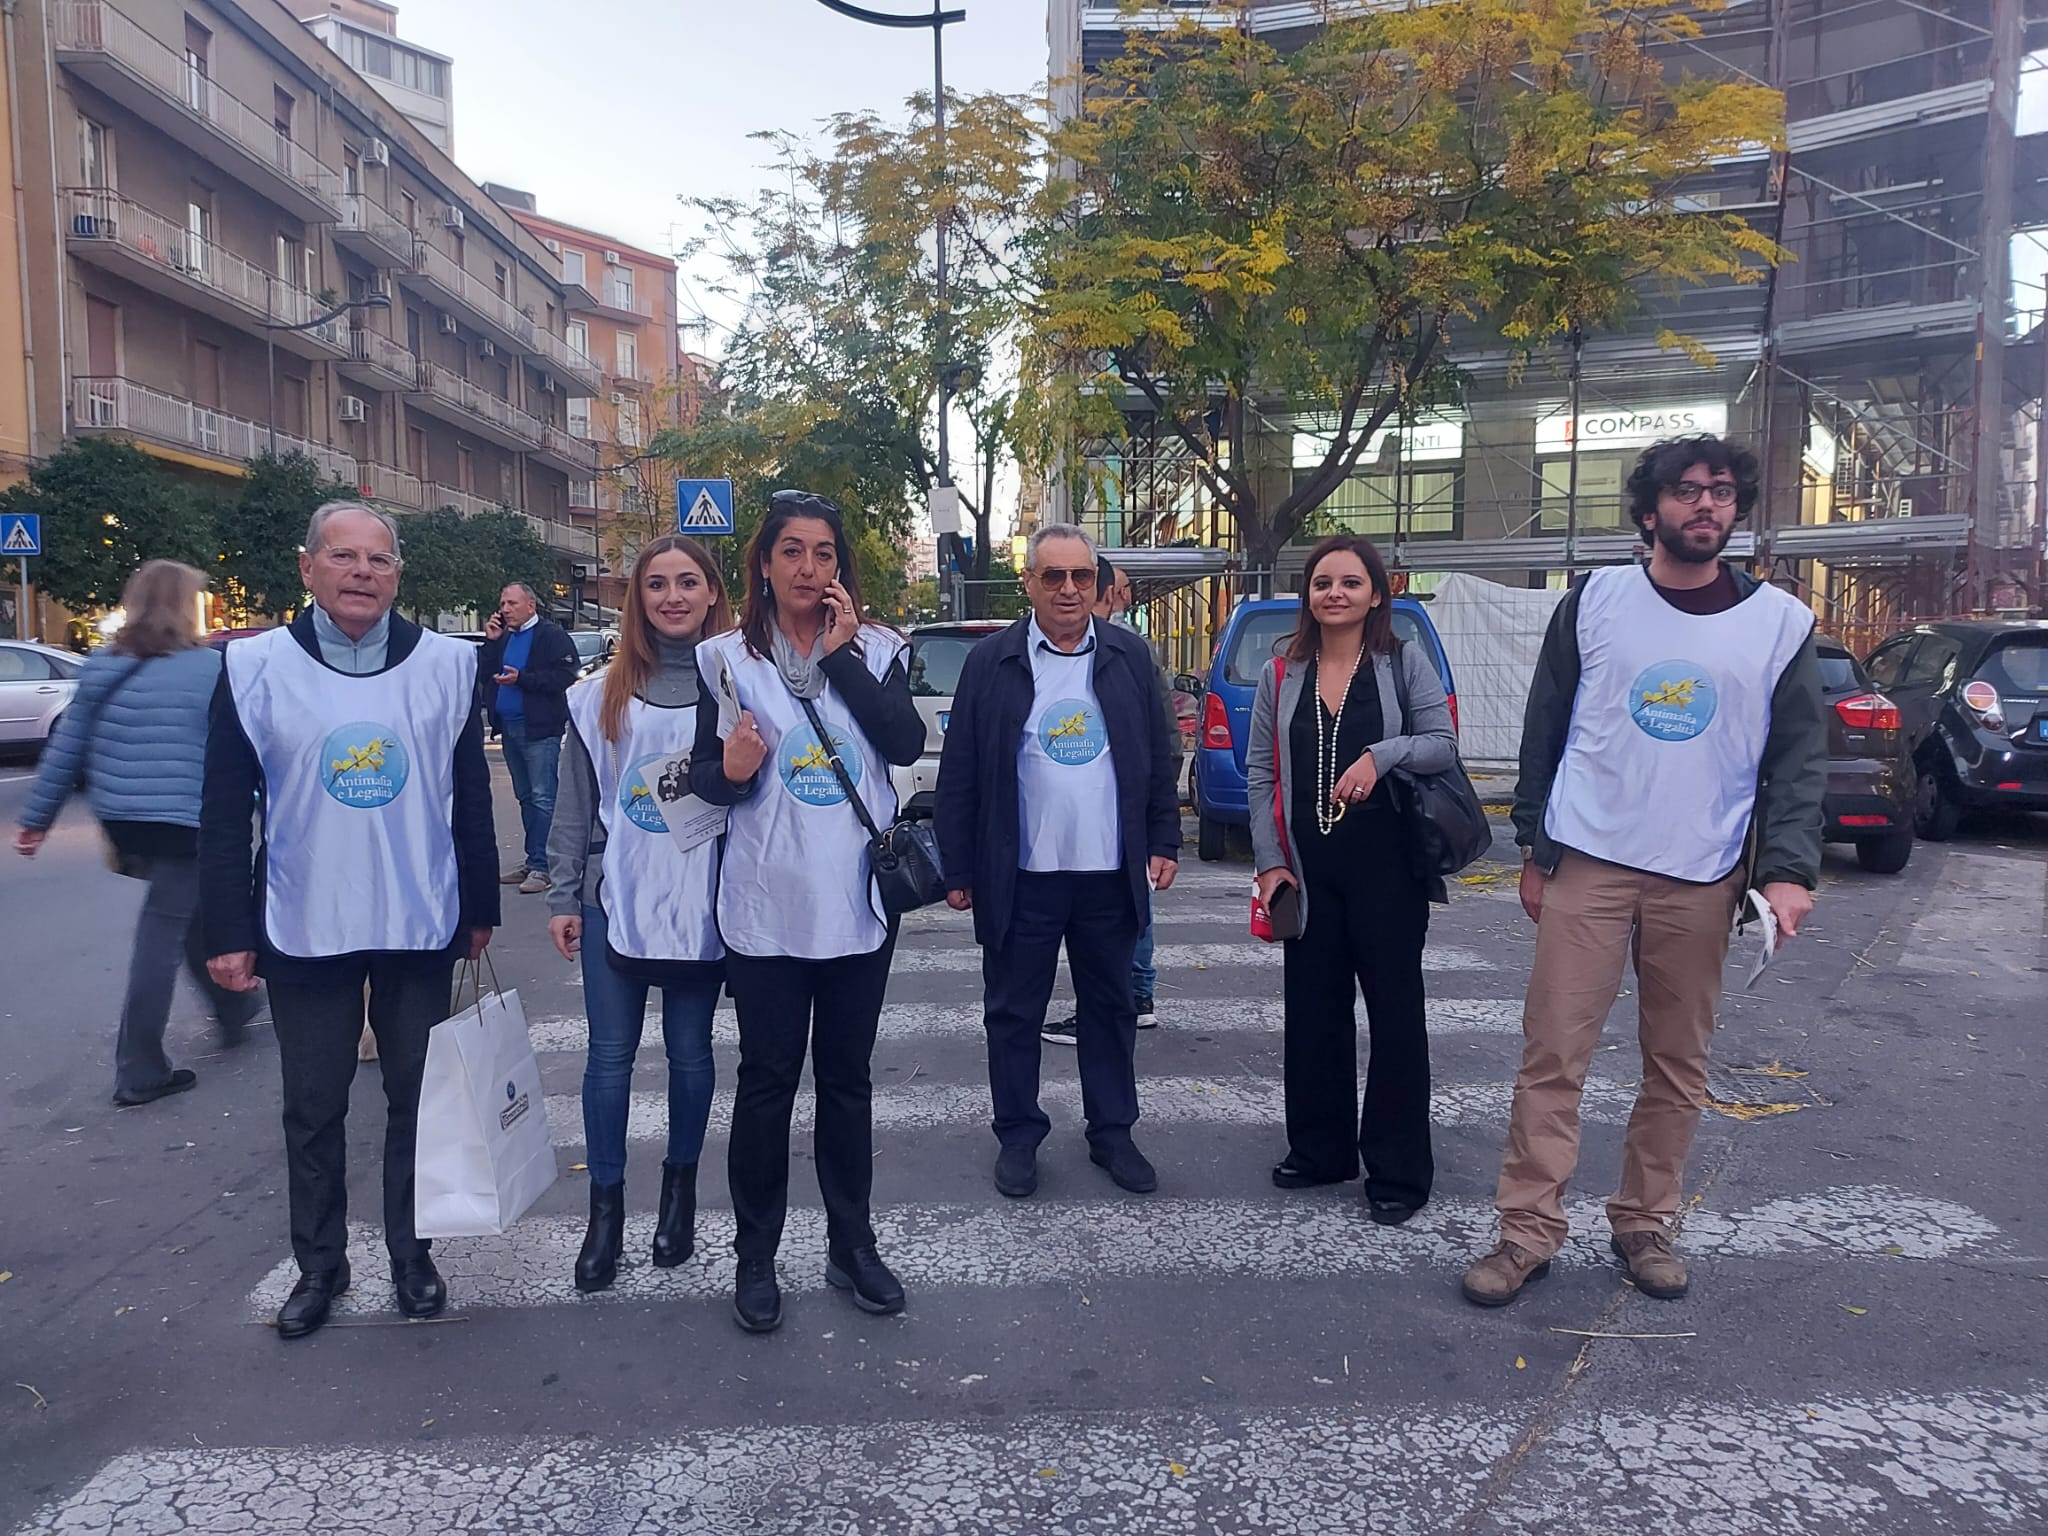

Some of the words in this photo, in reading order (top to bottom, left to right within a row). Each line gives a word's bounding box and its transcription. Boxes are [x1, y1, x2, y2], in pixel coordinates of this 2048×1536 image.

[1585, 413, 1696, 434] COMPASS
[1641, 706, 1697, 725] Antimafia
[1640, 719, 1647, 727] e
[1051, 739, 1095, 749] Antimafia
[1060, 748, 1096, 760] Legalità
[335, 775, 393, 788] Antimafia
[337, 790, 345, 800] e
[348, 786, 394, 801] Legalità
[794, 787, 802, 796] e
[631, 813, 639, 822] e
